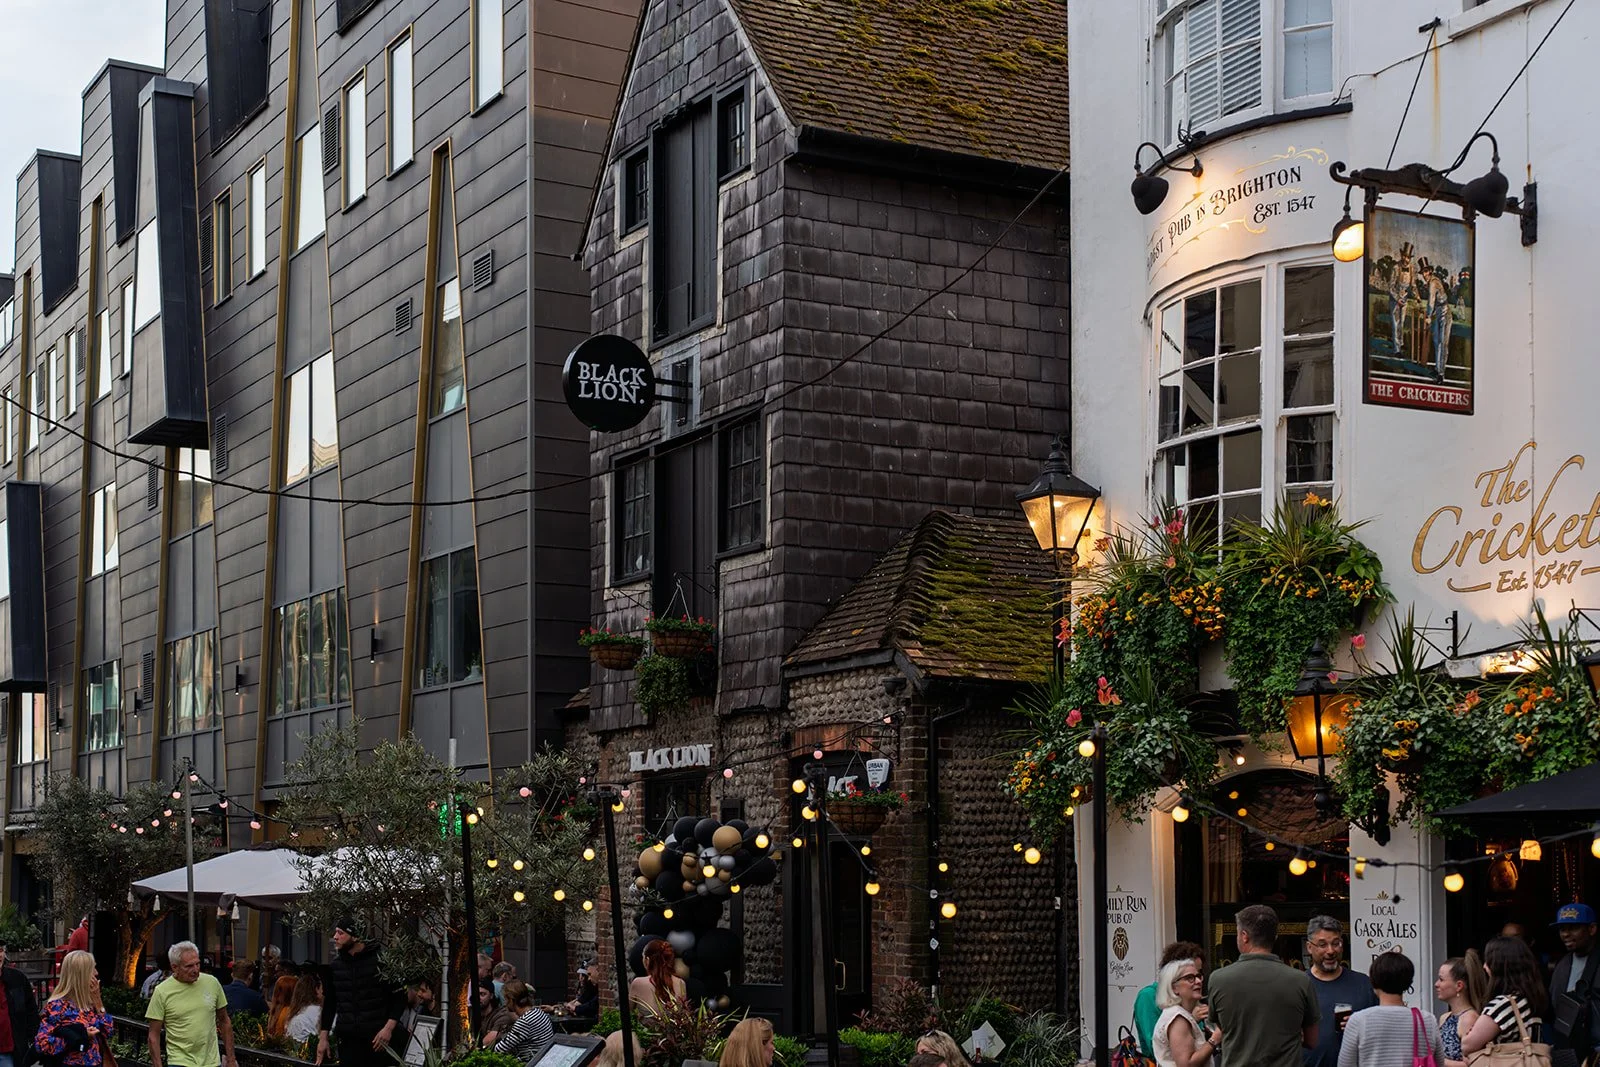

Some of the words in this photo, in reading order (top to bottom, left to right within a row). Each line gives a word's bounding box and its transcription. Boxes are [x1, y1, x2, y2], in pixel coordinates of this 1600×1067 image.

[1210, 165, 1302, 216] BRIGHTON
[1287, 196, 1315, 213] 1547
[577, 361, 647, 386] BLACK
[578, 380, 645, 404] LION.
[1370, 383, 1394, 397] THE
[1398, 386, 1470, 406] CRICKETERS
[1475, 441, 1537, 507] The
[1496, 569, 1528, 593] Est.
[1533, 559, 1583, 588] 1547
[629, 747, 672, 772] BLACK
[672, 743, 713, 769] LION
[1127, 895, 1147, 912] RUN
[1371, 904, 1398, 916] LOCAL
[1107, 913, 1122, 924] PUB
[1354, 918, 1384, 938] CASK
[1386, 919, 1417, 939] ALES
